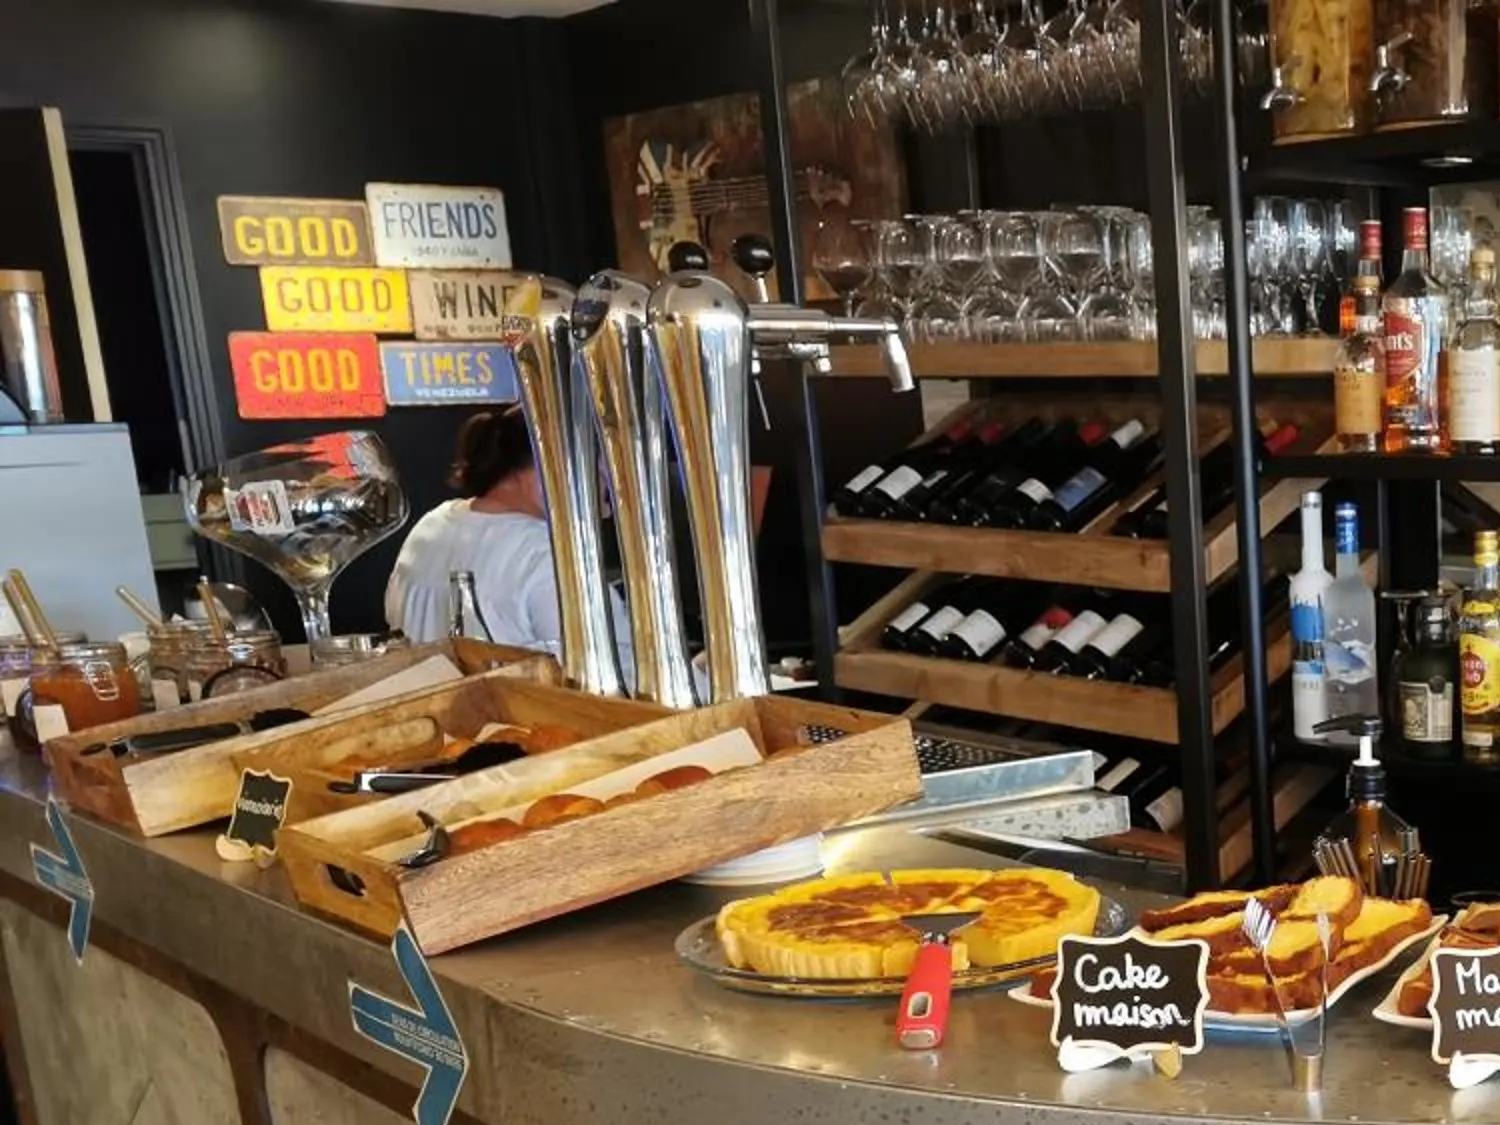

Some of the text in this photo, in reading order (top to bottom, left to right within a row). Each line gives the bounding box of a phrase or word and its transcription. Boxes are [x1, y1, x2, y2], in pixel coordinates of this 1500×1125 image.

[234, 216, 359, 257] GOOD
[382, 202, 497, 239] FRIENDS
[276, 277, 392, 313] GOOD
[251, 349, 361, 393] GOOD
[400, 352, 494, 386] TIMES
[414, 387, 490, 398] VENEZUELA
[1074, 952, 1170, 993] Cake
[1073, 995, 1191, 1029] maison
